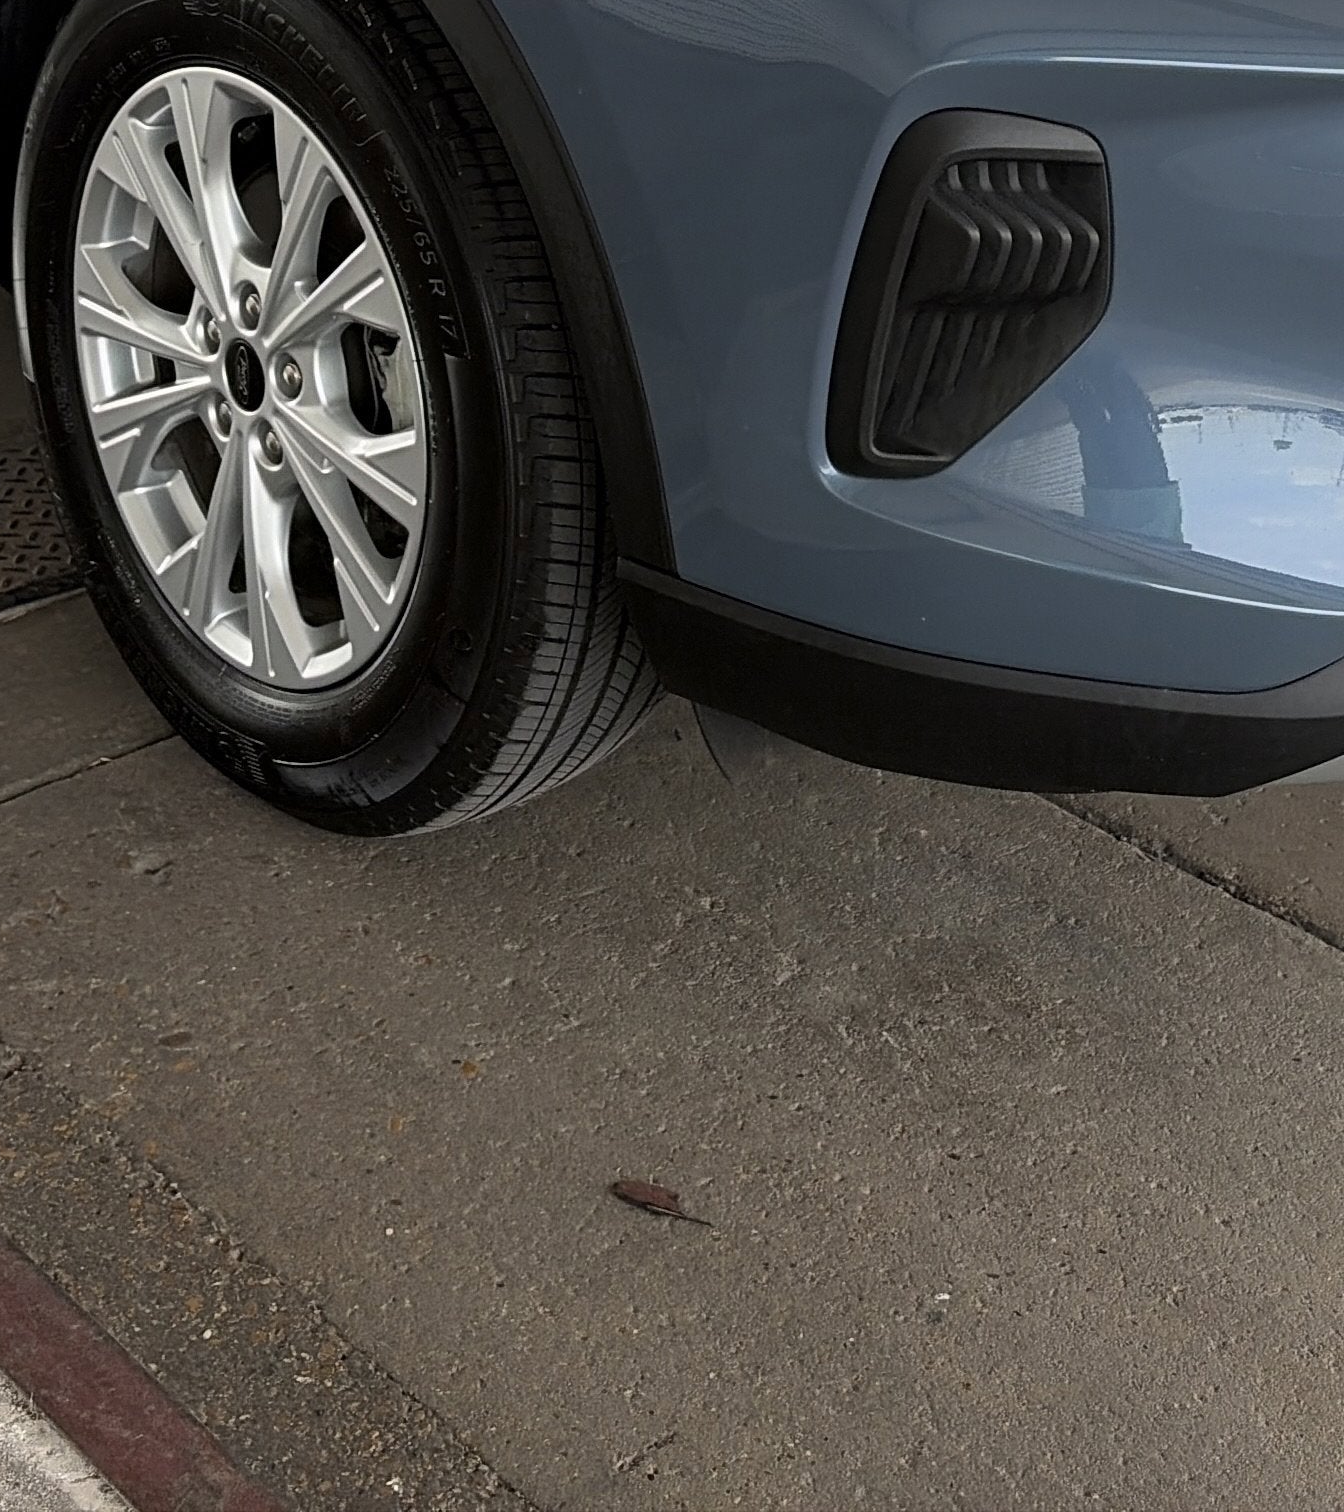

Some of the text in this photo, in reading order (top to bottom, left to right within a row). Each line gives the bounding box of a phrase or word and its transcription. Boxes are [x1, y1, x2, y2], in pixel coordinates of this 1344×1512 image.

[384, 165, 459, 340] 225/65 R 17
